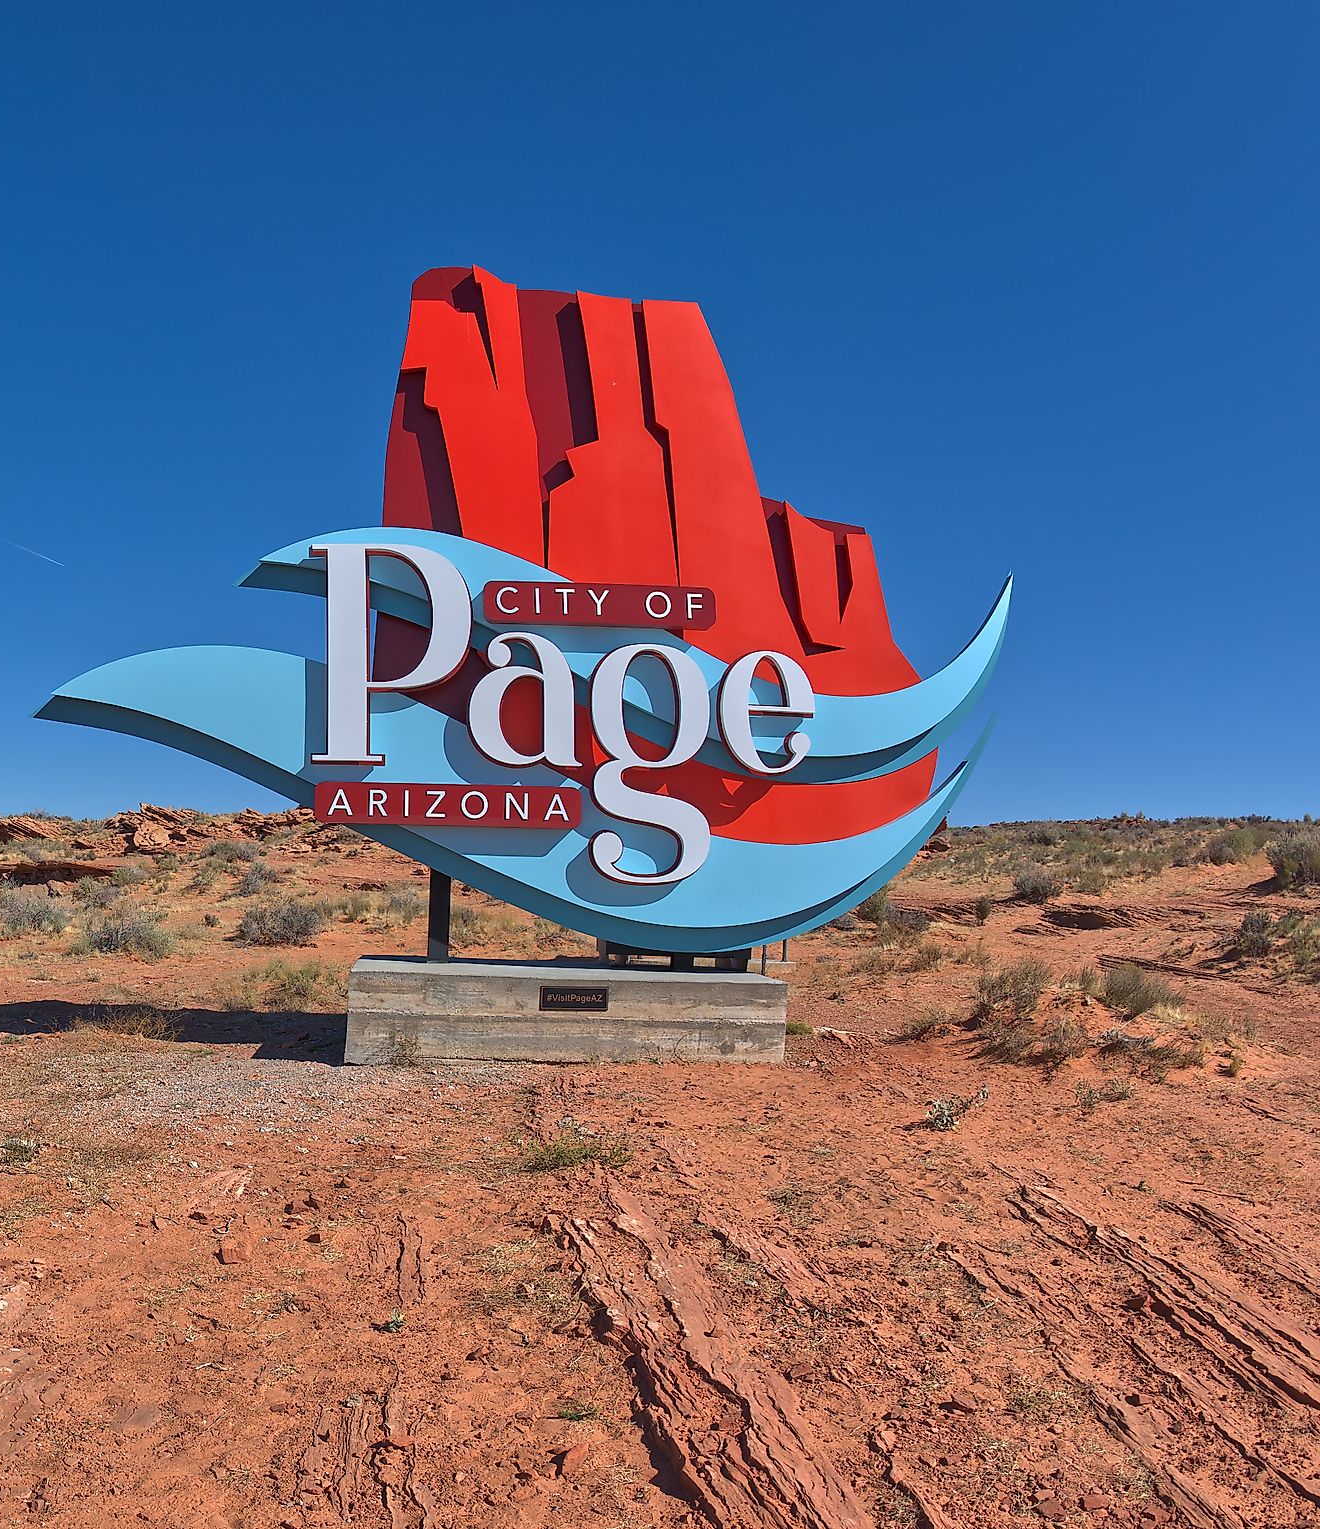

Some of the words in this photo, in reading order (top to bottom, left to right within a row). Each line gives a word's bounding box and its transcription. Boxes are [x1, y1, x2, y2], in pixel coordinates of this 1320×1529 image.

[495, 586, 608, 616] CITY
[644, 591, 705, 620] OF
[309, 543, 816, 886] Page
[328, 789, 570, 822] ARIZONA
[546, 993, 604, 1004] #VisitPageAZ
